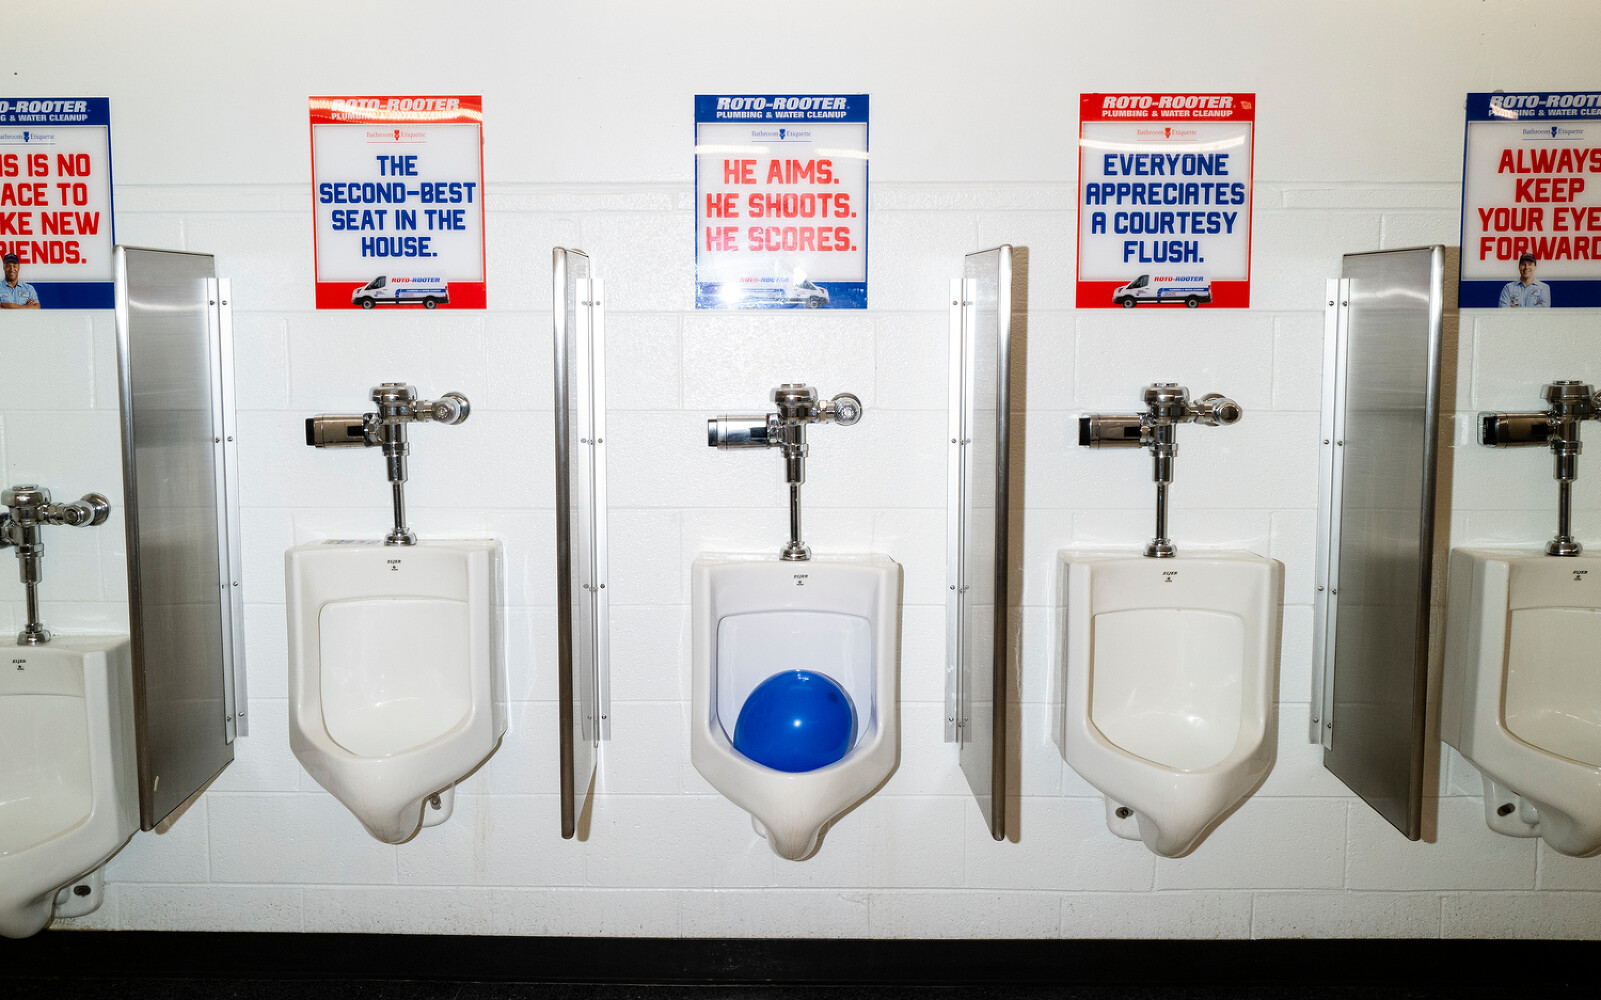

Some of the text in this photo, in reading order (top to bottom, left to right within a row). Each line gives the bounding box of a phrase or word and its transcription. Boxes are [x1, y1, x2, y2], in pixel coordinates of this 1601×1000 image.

[716, 97, 847, 110] ROTO-ROOTER
[1102, 96, 1233, 109] ROTO-ROOTER
[1548, 108, 1578, 116] WATER
[9, 114, 16, 122] &
[18, 114, 47, 122] WATER
[49, 114, 88, 122] CLEANUP
[716, 111, 763, 119] PLUMBING
[1558, 128, 1584, 136] Etiquette
[27, 154, 49, 177] IS
[57, 154, 91, 177] NO
[376, 155, 418, 176] THE
[724, 159, 840, 184] HE AIMS.
[1103, 153, 1229, 176] EVERYONE
[1497, 148, 1601, 174] ALWAYS
[1, 183, 88, 206] ACE TO
[319, 182, 477, 204] SECOND-BEST
[1086, 182, 1245, 205] APPRECIATES
[1515, 177, 1585, 203] KEEP
[706, 193, 857, 218] HE SHOOTS.
[41, 211, 100, 236] NEW
[331, 209, 466, 231] SEAT IN THE
[1091, 211, 1238, 234] A COURTESY
[1478, 207, 1601, 232] YOUR EYE
[361, 236, 438, 257] HOUSE.
[706, 226, 857, 251] HE SCORES.
[1479, 236, 1601, 261] FORWARD
[1123, 240, 1204, 263] FLUSH.
